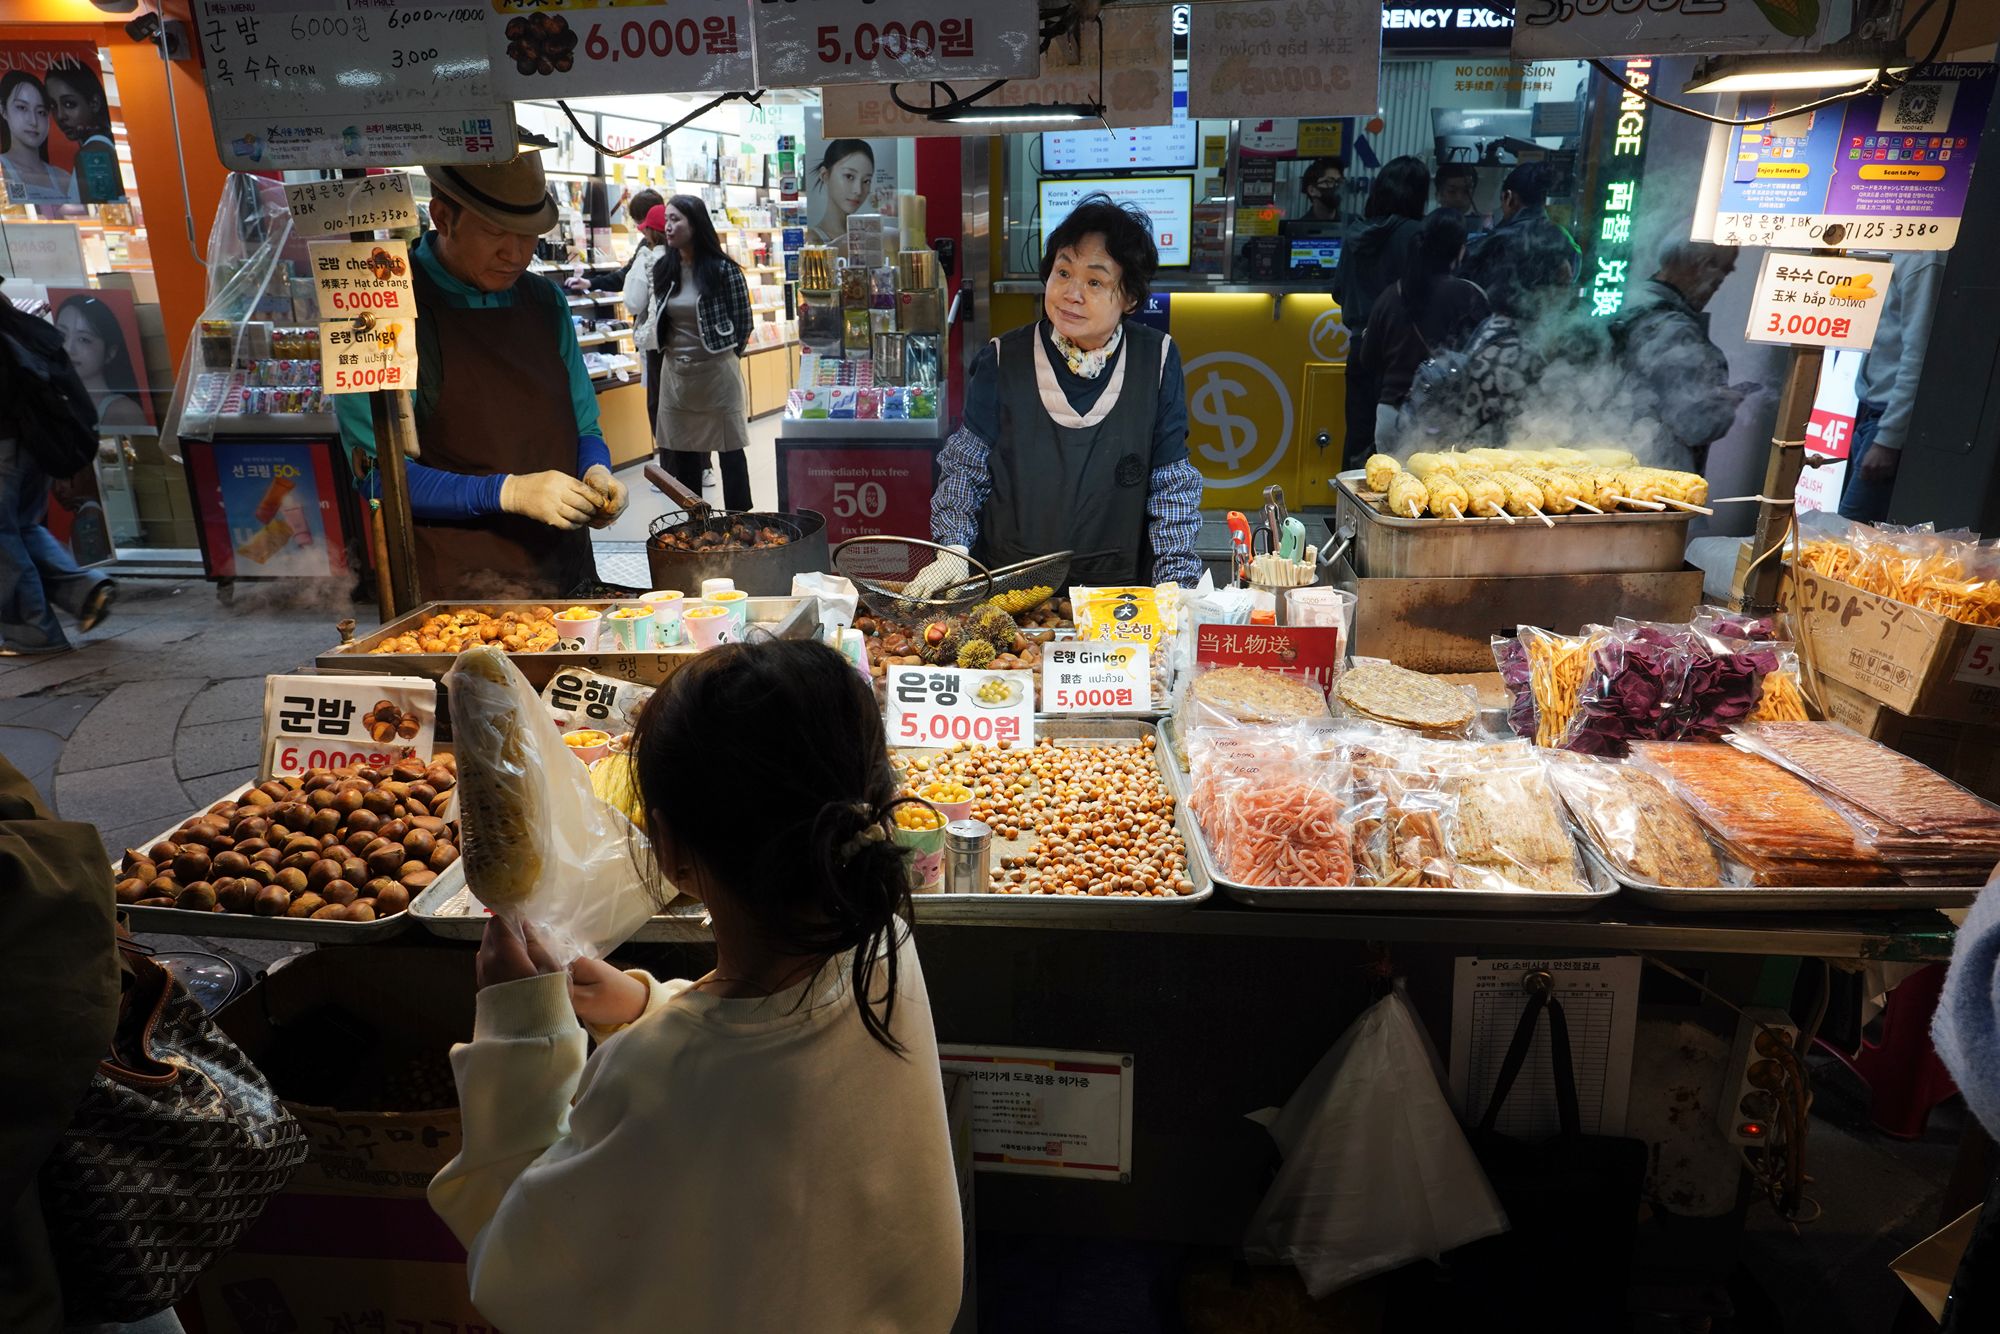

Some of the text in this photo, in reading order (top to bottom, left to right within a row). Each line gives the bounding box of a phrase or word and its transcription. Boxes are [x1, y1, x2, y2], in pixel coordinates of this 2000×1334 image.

[585, 16, 738, 62] 6,000원
[817, 18, 974, 64] 5,000원
[1455, 66, 1473, 77] NO
[1757, 166, 1801, 176] Enjoy Benefits
[1907, 169, 1921, 178] Pay
[292, 204, 316, 216] IBK
[323, 209, 409, 231] 010-7125-3580
[318, 257, 340, 271] 군밤
[387, 279, 409, 290] rang
[1776, 266, 1852, 287] 옥수수 Corn
[333, 291, 399, 311] 6,000원
[1772, 289, 1797, 303] 玉米
[1803, 291, 1826, 307] bắp
[1767, 313, 1851, 338] 3,000원
[330, 330, 396, 345] 은행 Ginkgo
[339, 354, 359, 365] 銀杏
[336, 367, 401, 389] 5,000원
[807, 467, 910, 479] immediately tax free
[832, 481, 887, 518] 50
[841, 525, 881, 535] tax free
[1115, 621, 1152, 640] 은행
[1199, 633, 1290, 655] 当礼物送
[1053, 650, 1126, 667] 은행 Ginkgo
[1060, 673, 1082, 685] 銀杏
[551, 674, 618, 720] 은행
[896, 672, 960, 706] 은행
[1057, 688, 1133, 709] 5,000원
[279, 695, 356, 736] 군밤
[900, 713, 1020, 742] 5,000원
[1492, 961, 1509, 970] LPG
[969, 1070, 1090, 1088] 거리가게 도로점용 허가증
